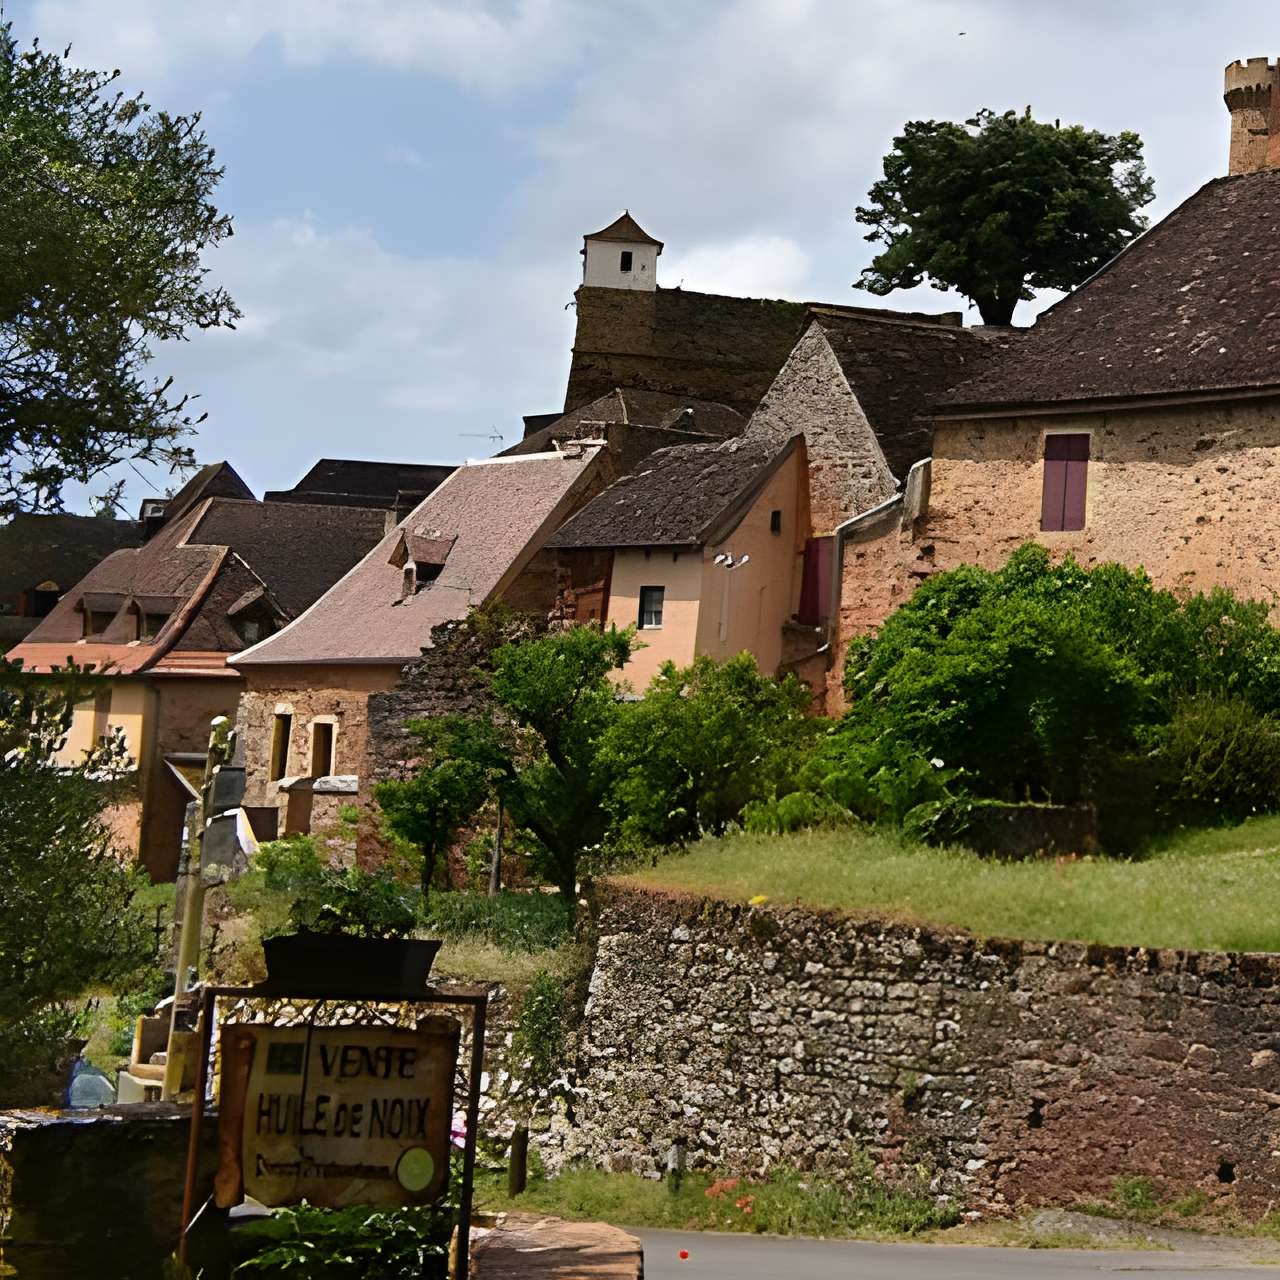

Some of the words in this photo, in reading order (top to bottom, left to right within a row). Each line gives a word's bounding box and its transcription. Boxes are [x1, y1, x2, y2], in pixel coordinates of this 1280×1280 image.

[319, 1044, 417, 1079] VENTE
[255, 1093, 331, 1137] HUILE
[367, 1097, 431, 1139] NOIX
